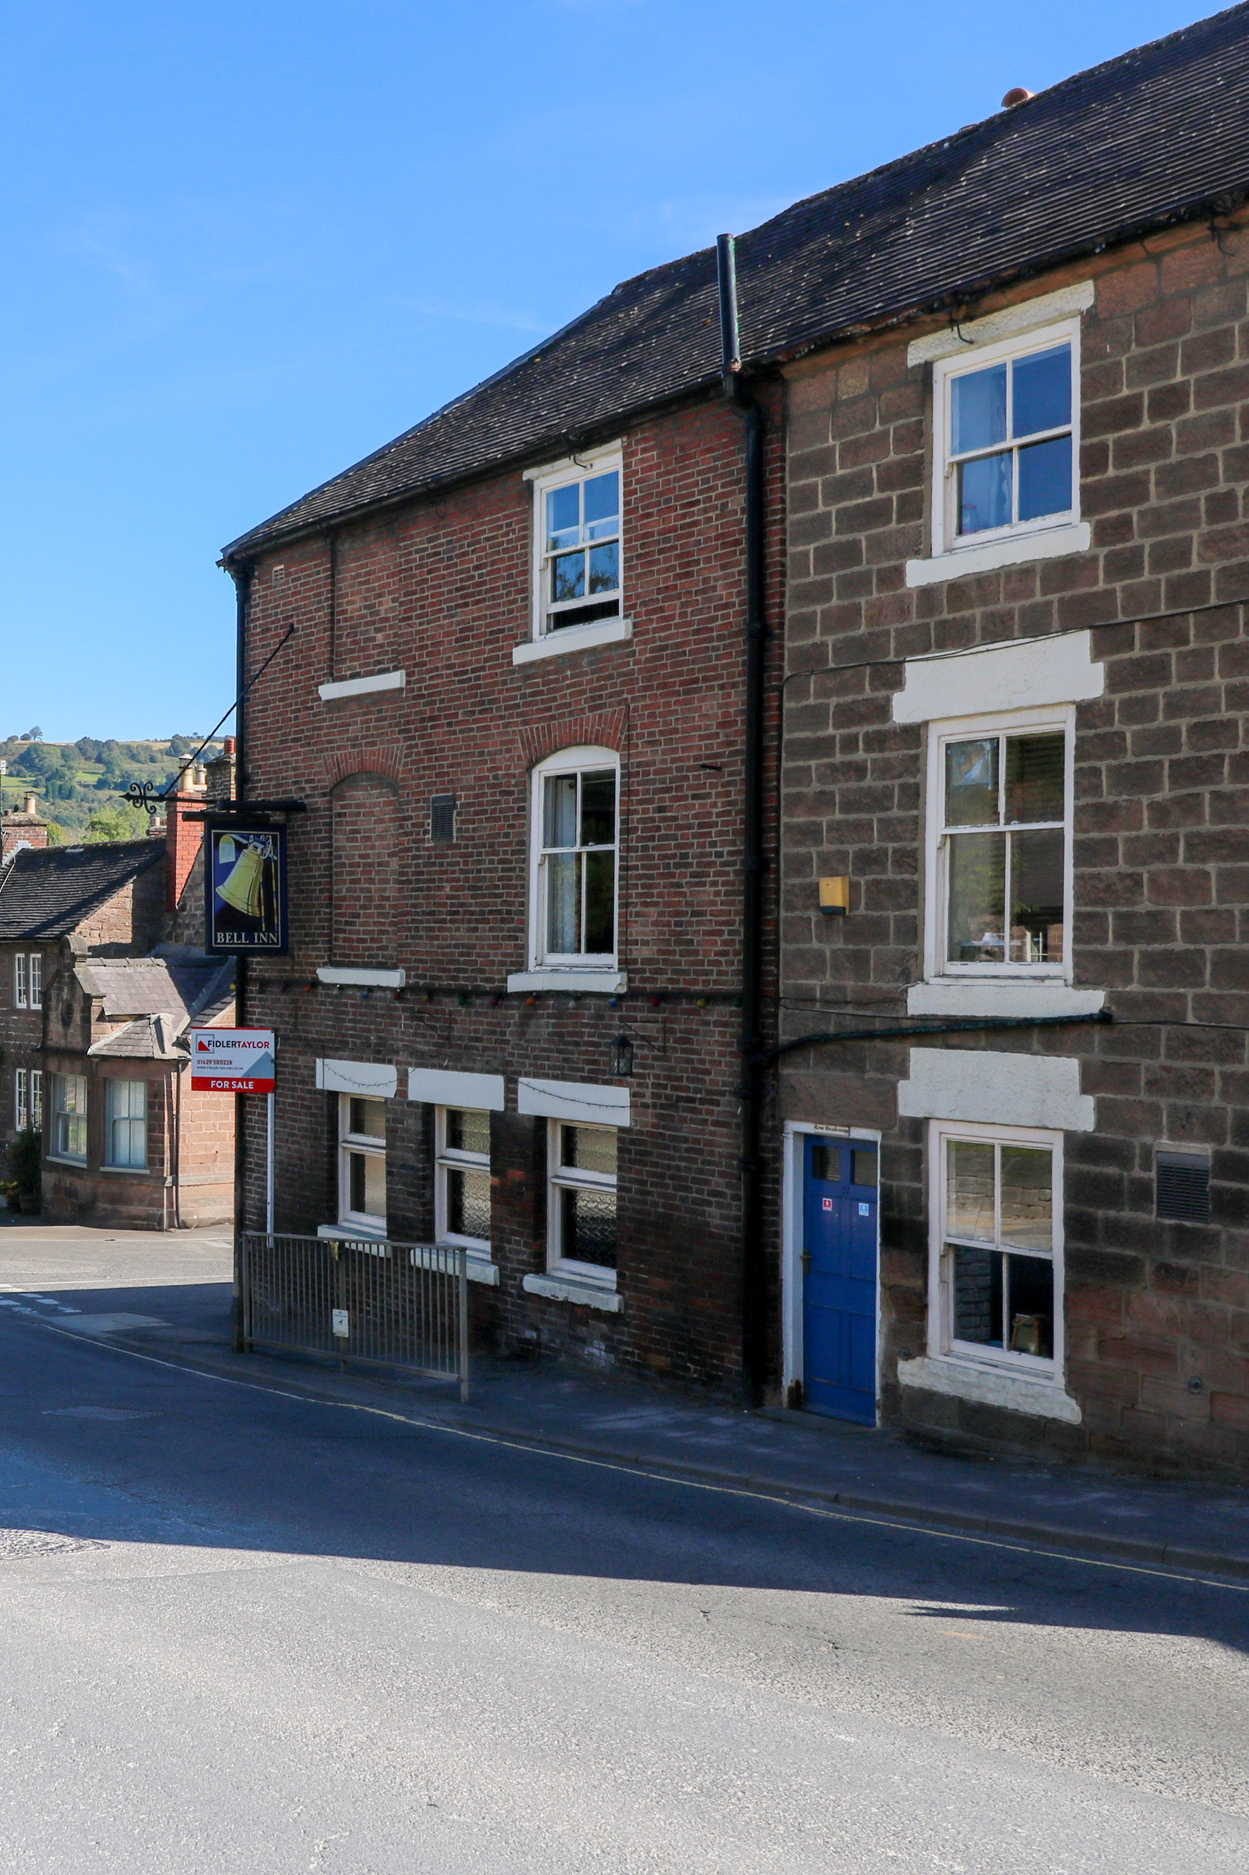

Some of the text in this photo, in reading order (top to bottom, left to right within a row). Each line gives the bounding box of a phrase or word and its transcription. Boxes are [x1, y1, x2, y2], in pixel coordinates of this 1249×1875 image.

[216, 932, 278, 944] BELL INN
[207, 1040, 270, 1049] FIDLERTAYLOR
[211, 1080, 254, 1090] FOR SALE
